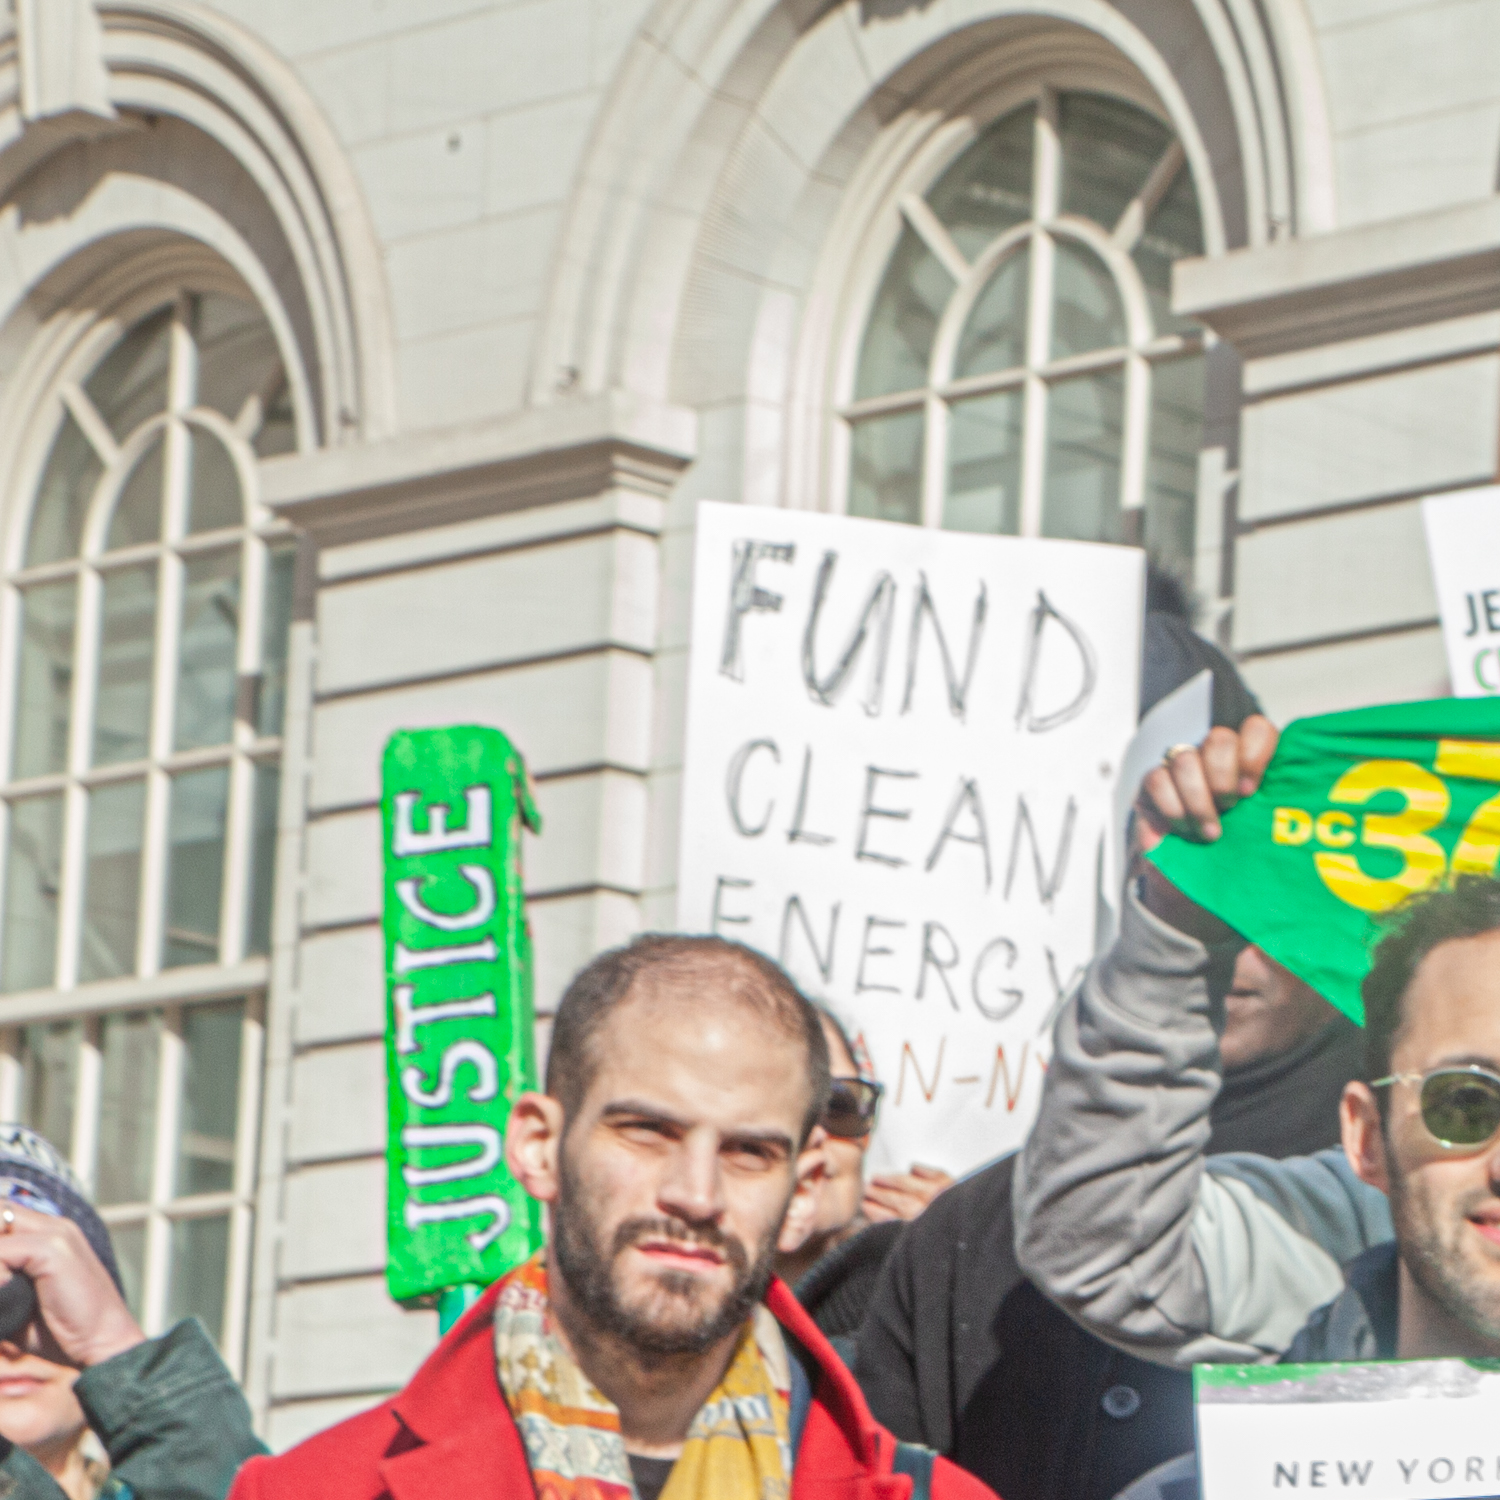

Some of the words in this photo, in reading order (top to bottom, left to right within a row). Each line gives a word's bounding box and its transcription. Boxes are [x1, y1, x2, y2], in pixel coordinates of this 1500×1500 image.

[718, 536, 1099, 734] FUND
[724, 735, 1078, 915] CLEAN
[1272, 806, 1357, 849] DC
[394, 783, 512, 1252] JUSTICE
[711, 873, 1086, 1038] ENERGY
[1273, 1460, 1374, 1489] NEW
